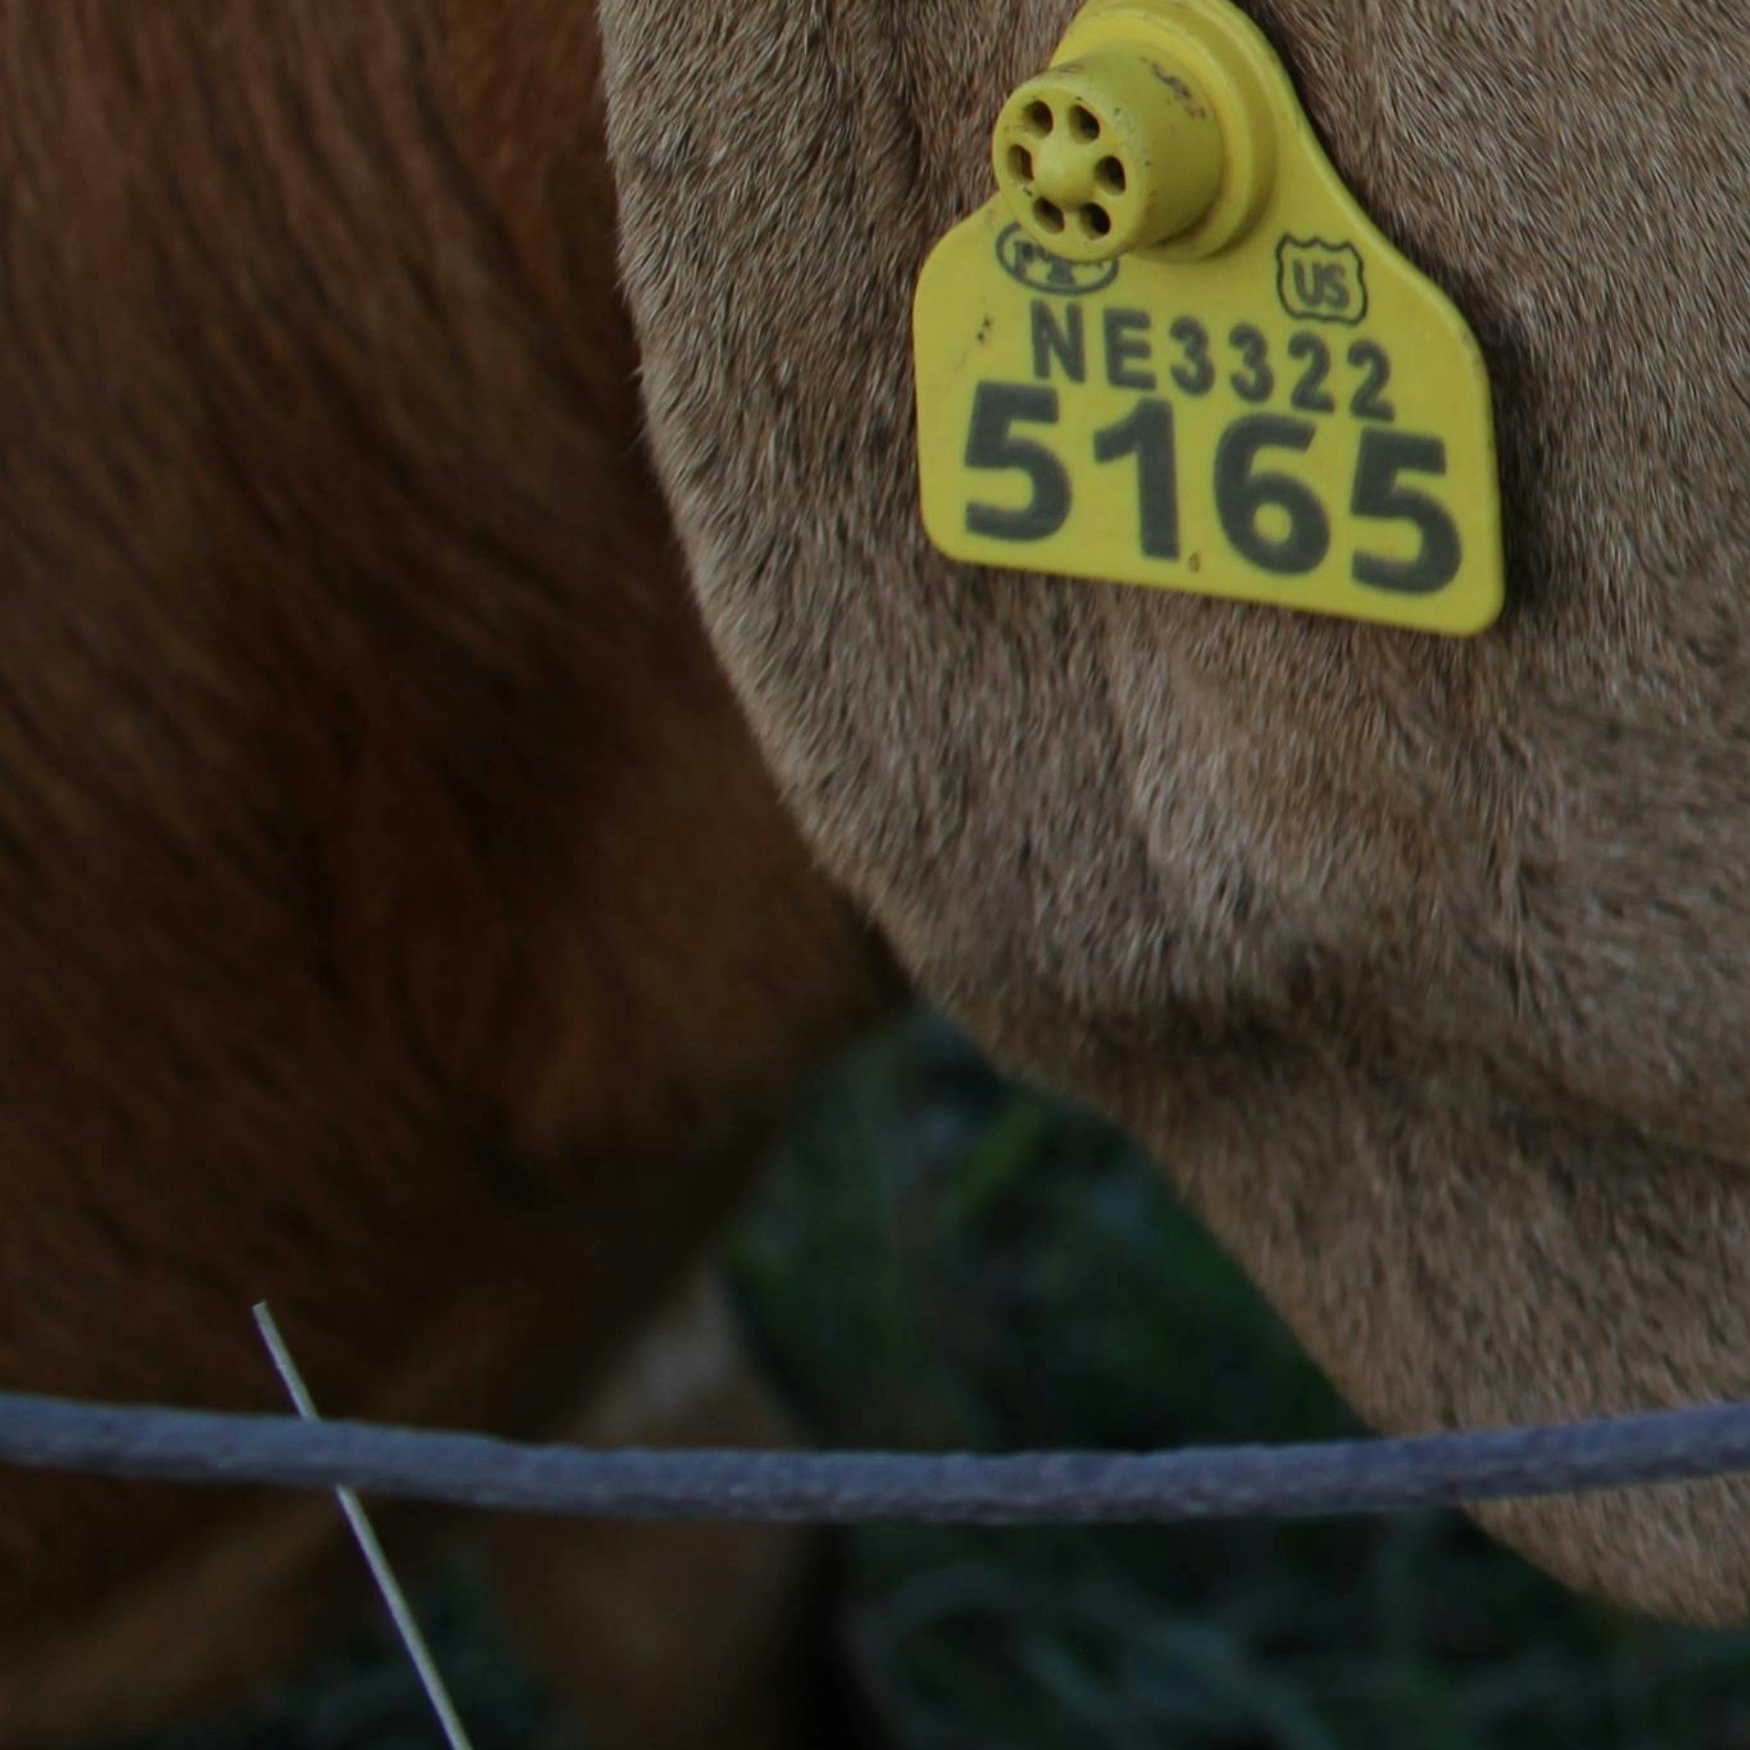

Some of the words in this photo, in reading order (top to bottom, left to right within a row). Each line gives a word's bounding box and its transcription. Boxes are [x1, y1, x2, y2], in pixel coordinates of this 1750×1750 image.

[1294, 260, 1350, 308] US
[1031, 301, 1395, 422] NE3322
[964, 381, 1462, 595] 5165
